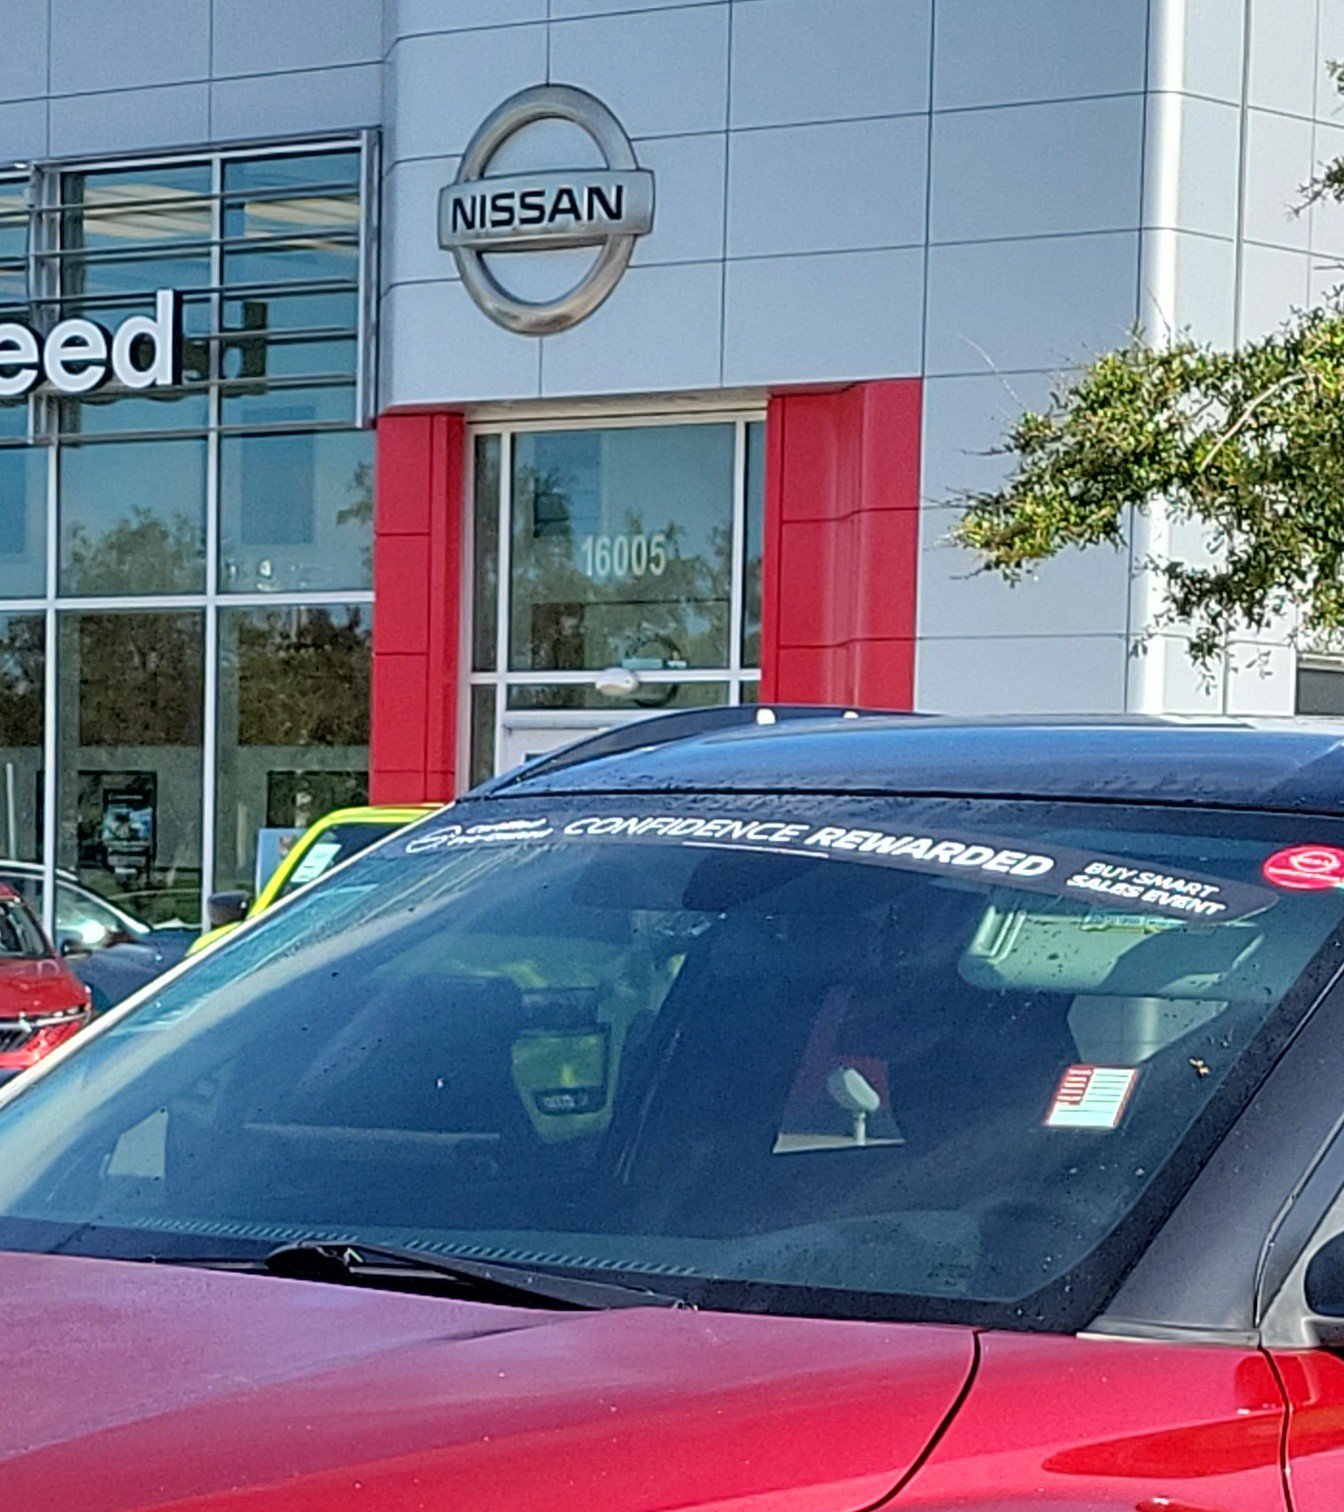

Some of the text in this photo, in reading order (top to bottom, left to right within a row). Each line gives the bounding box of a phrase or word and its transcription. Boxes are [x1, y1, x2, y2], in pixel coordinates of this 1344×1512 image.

[451, 184, 624, 232] NISSAN
[582, 534, 667, 577] 16005
[564, 817, 809, 843] CONFIDENCE
[804, 826, 1056, 877] REWARDED
[1066, 874, 1228, 915] SALES EVENT
[1084, 861, 1220, 898] BUY SMART
